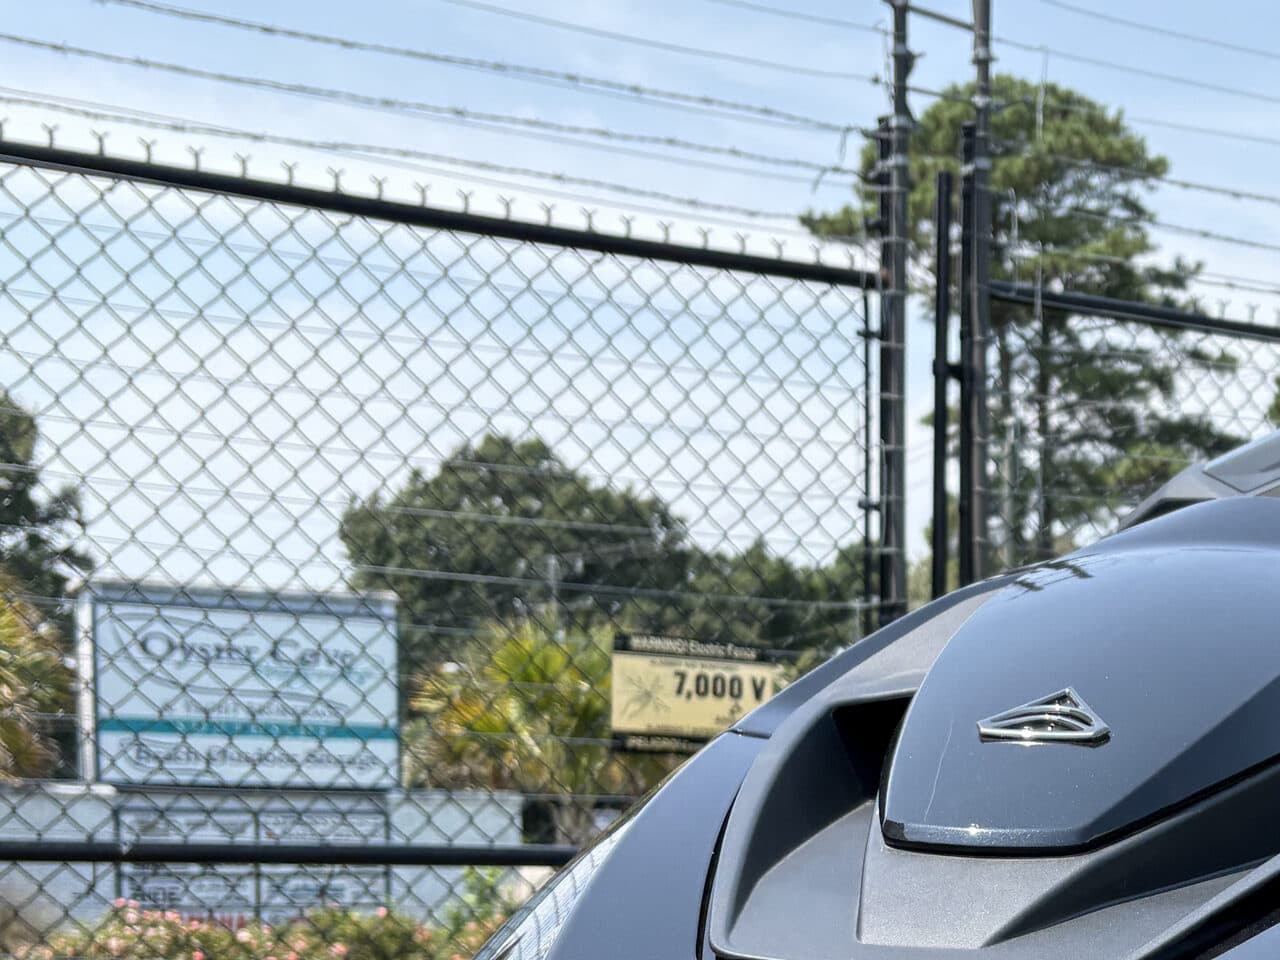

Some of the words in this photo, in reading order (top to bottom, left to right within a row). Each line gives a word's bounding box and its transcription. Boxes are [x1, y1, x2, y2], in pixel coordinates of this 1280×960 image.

[141, 632, 261, 668] Oyster
[674, 671, 743, 700] 7,000
[752, 676, 766, 700] V
